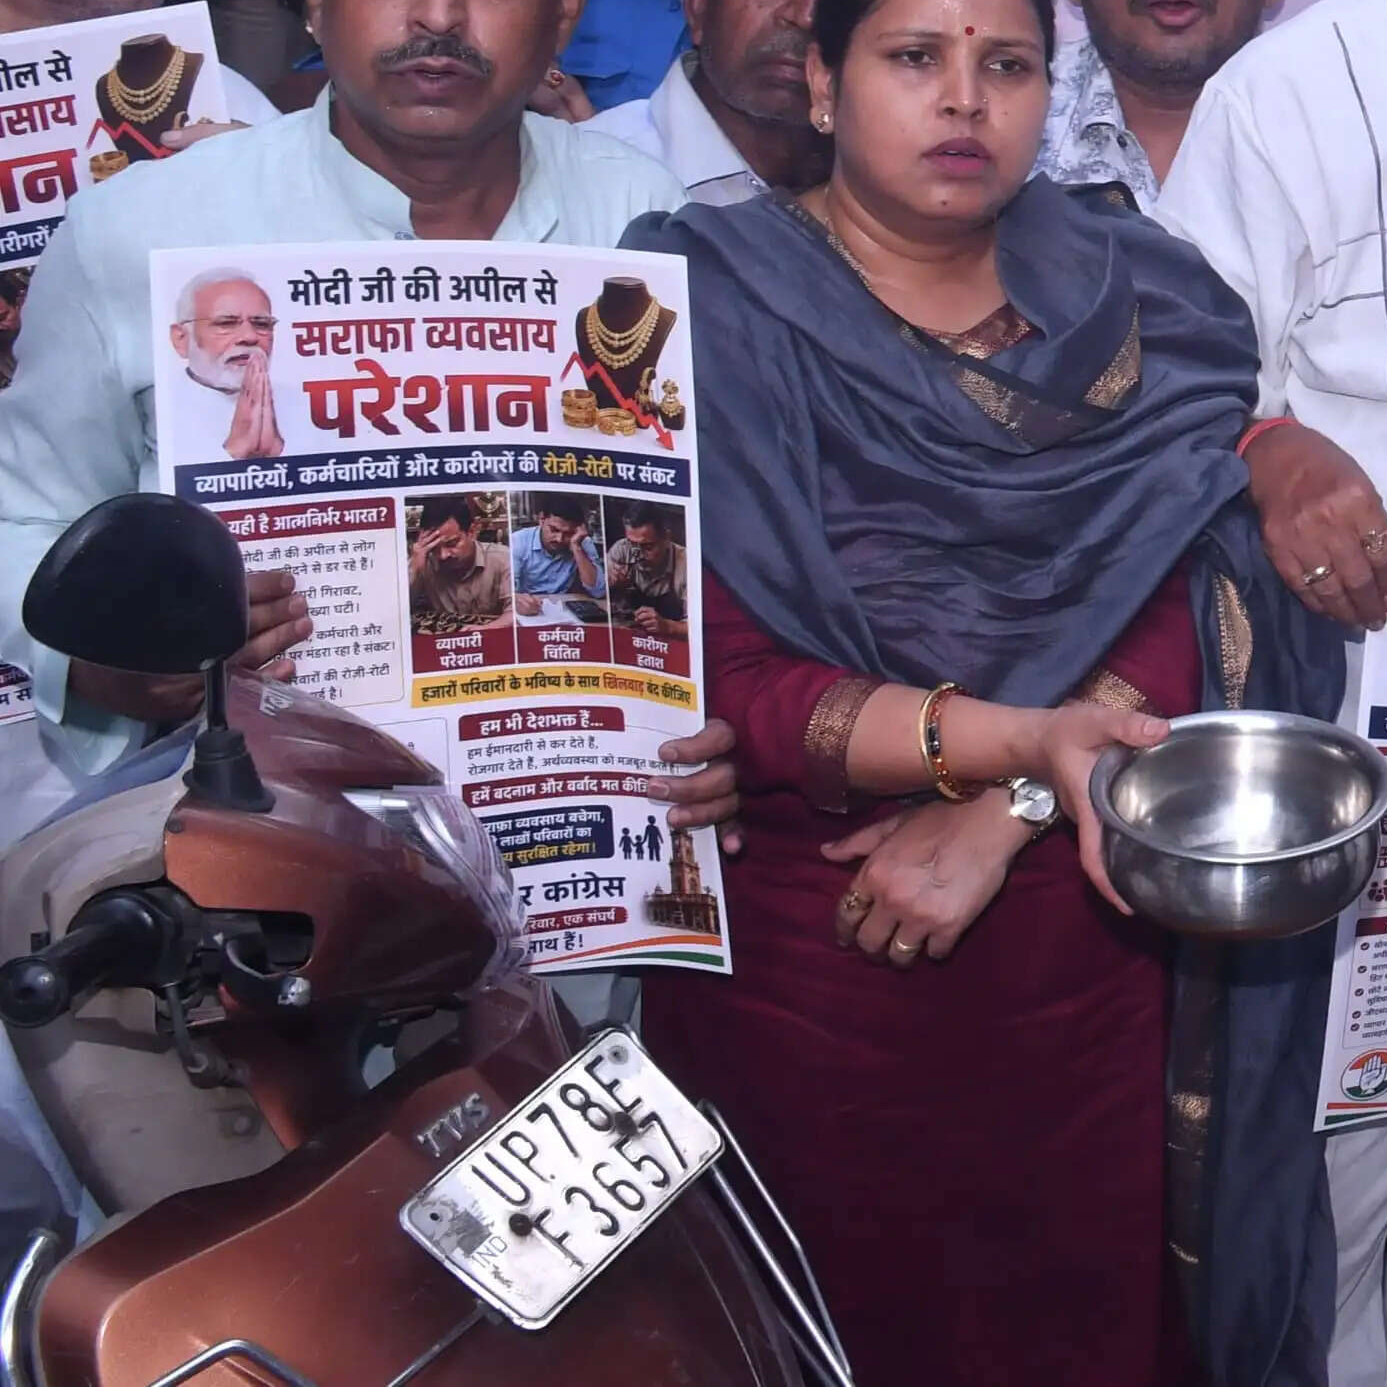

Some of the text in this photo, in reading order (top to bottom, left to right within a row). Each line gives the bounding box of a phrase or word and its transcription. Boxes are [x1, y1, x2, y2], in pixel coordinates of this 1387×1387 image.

[44, 49, 73, 83] से
[287, 266, 559, 306] मोदी जी की अपील से
[291, 316, 558, 358] सराफा व्यवसाय
[302, 358, 552, 439] परेशान
[193, 450, 676, 494] व्यापारियों, कर्मचारियों और कारीगरों की रोज़ी-रोटी पर संकट
